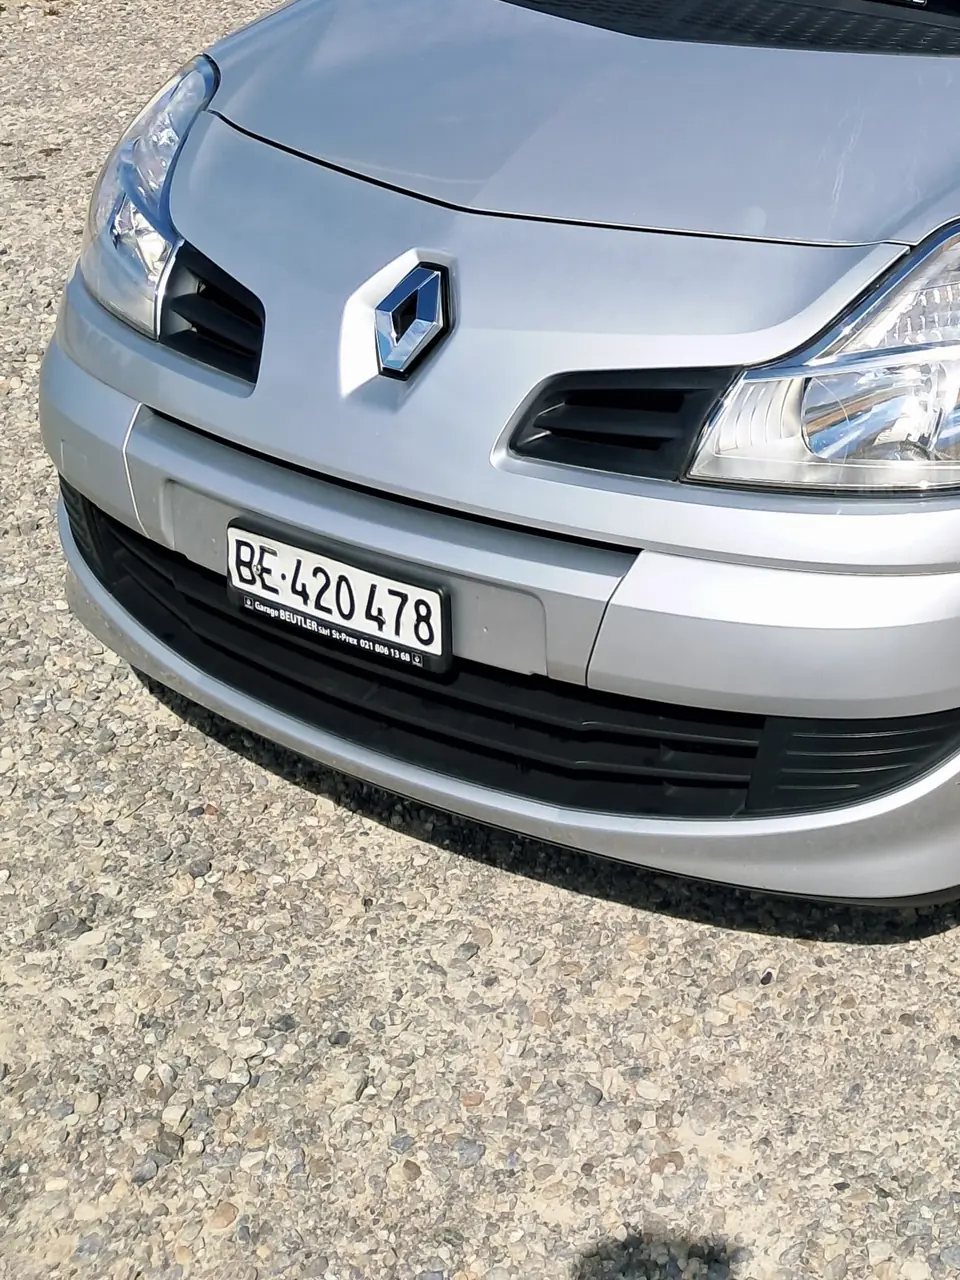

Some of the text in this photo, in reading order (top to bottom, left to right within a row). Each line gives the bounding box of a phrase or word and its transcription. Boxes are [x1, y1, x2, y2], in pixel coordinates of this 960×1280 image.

[254, 601, 279, 618] Garage
[279, 609, 318, 632] BEUTLER
[331, 629, 358, 646] St-Prex
